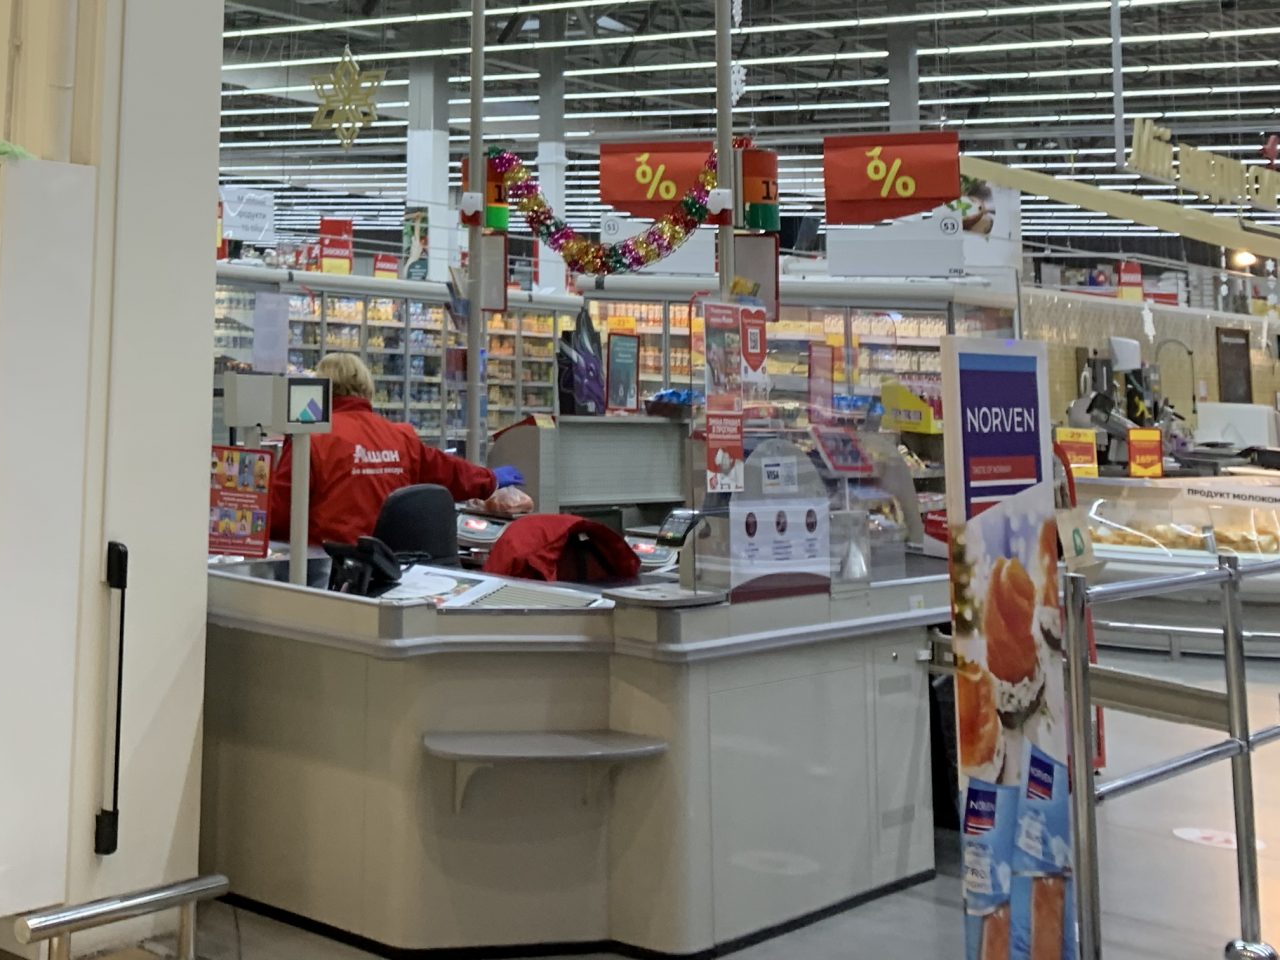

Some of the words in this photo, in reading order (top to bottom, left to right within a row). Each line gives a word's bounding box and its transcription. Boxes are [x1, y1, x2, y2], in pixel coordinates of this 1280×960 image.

[966, 406, 1035, 434] NORVEN
[353, 444, 400, 464] Ашан
[1187, 488, 1231, 499] ПРОДУКТ
